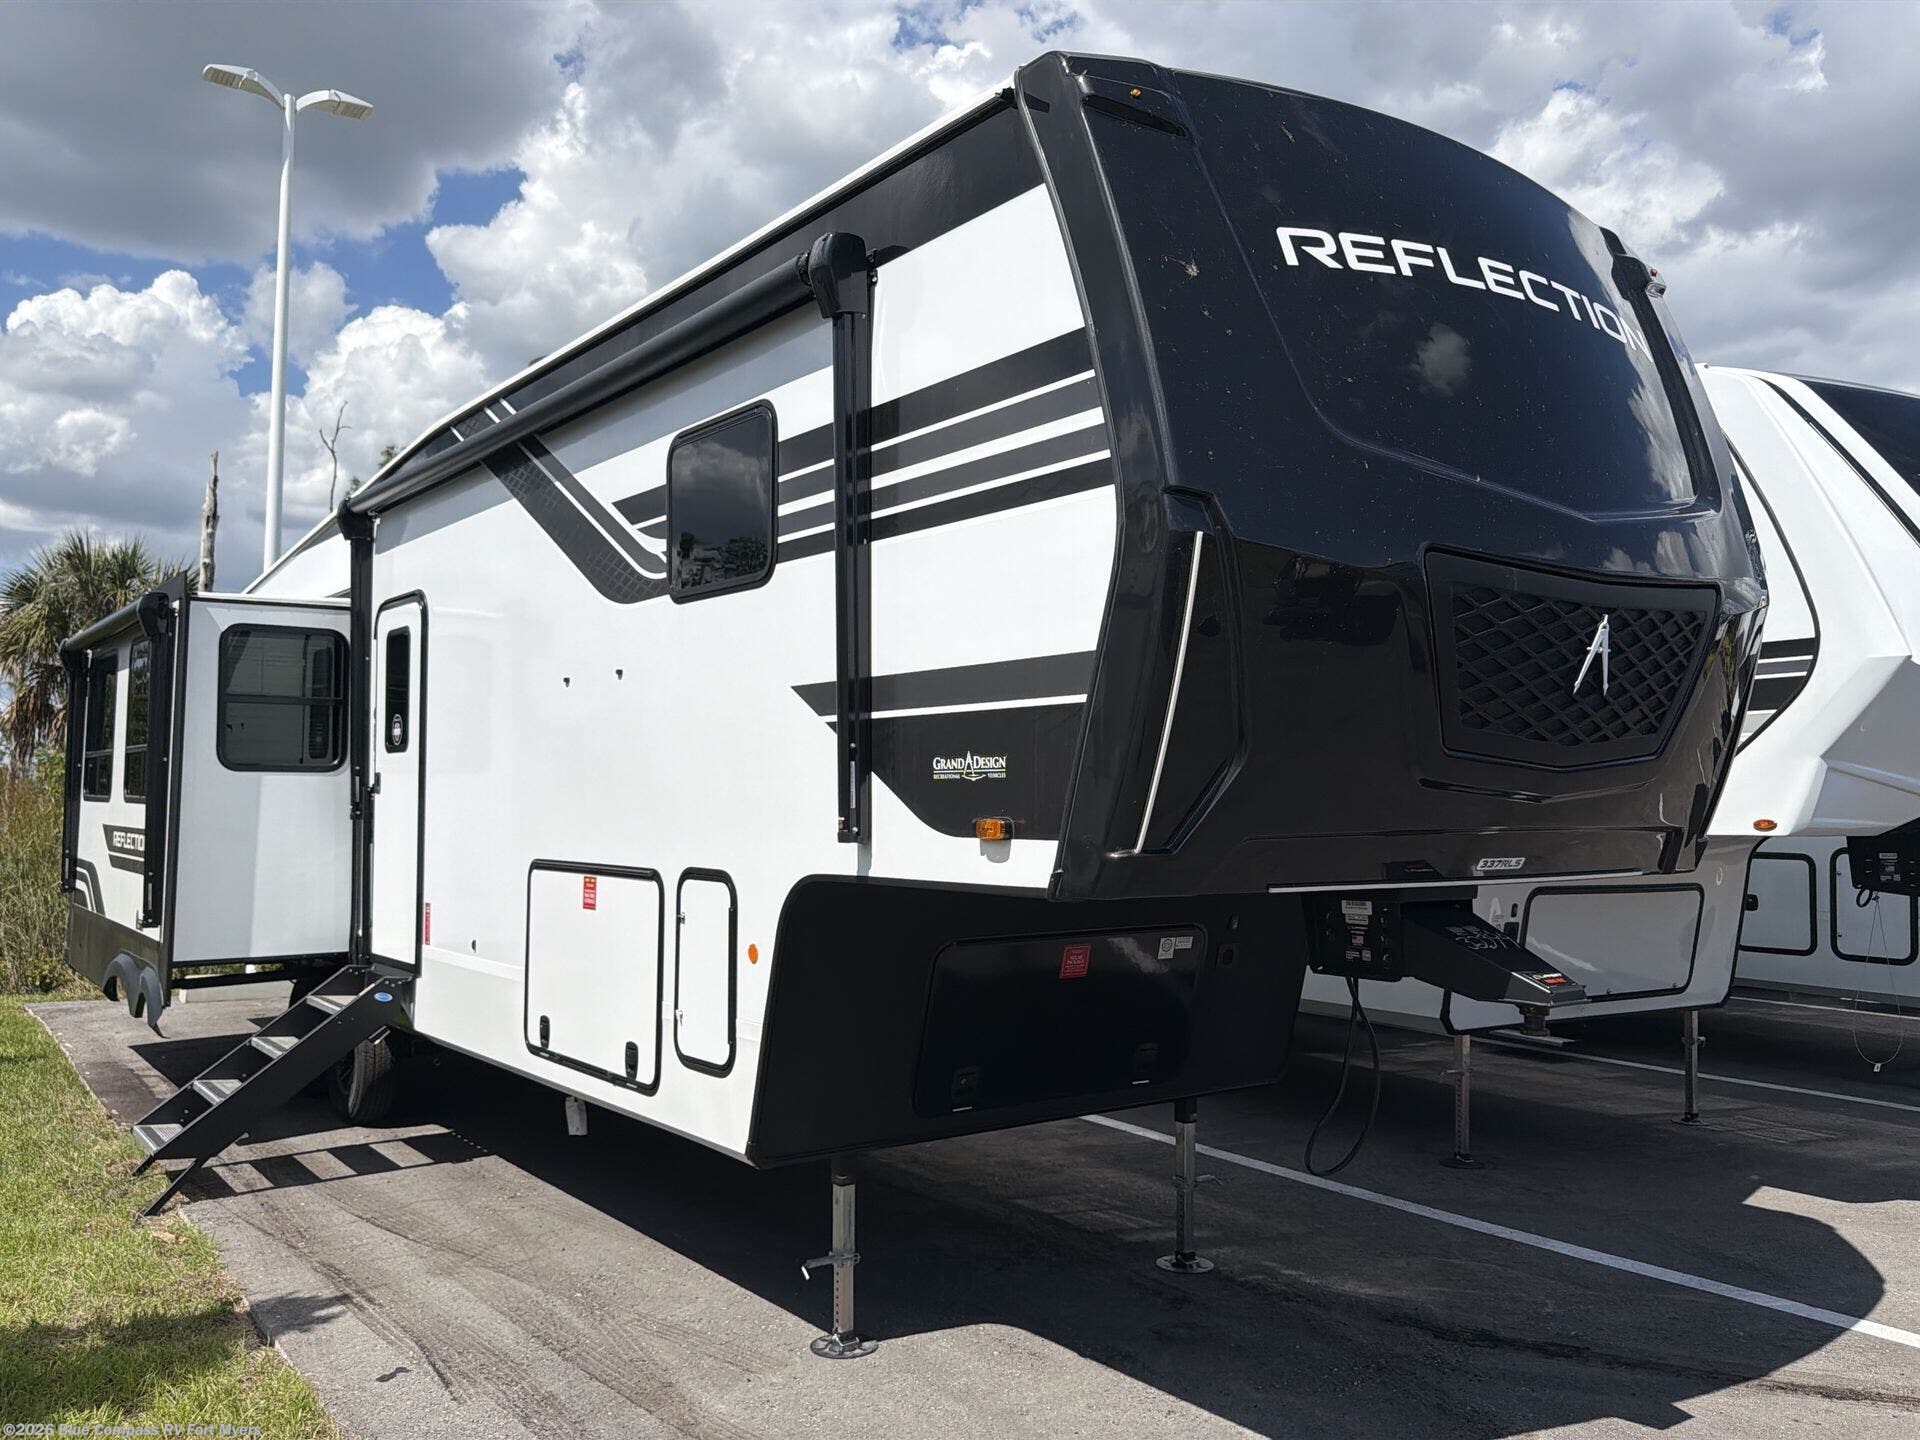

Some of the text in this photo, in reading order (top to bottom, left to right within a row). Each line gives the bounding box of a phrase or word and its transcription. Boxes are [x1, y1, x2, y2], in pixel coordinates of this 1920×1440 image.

[1276, 226, 1653, 363] REFLECTION
[933, 756, 1006, 770] GRAND DESIGN
[113, 831, 145, 851] REFLECTIO
[1479, 859, 1523, 869] 337RLS
